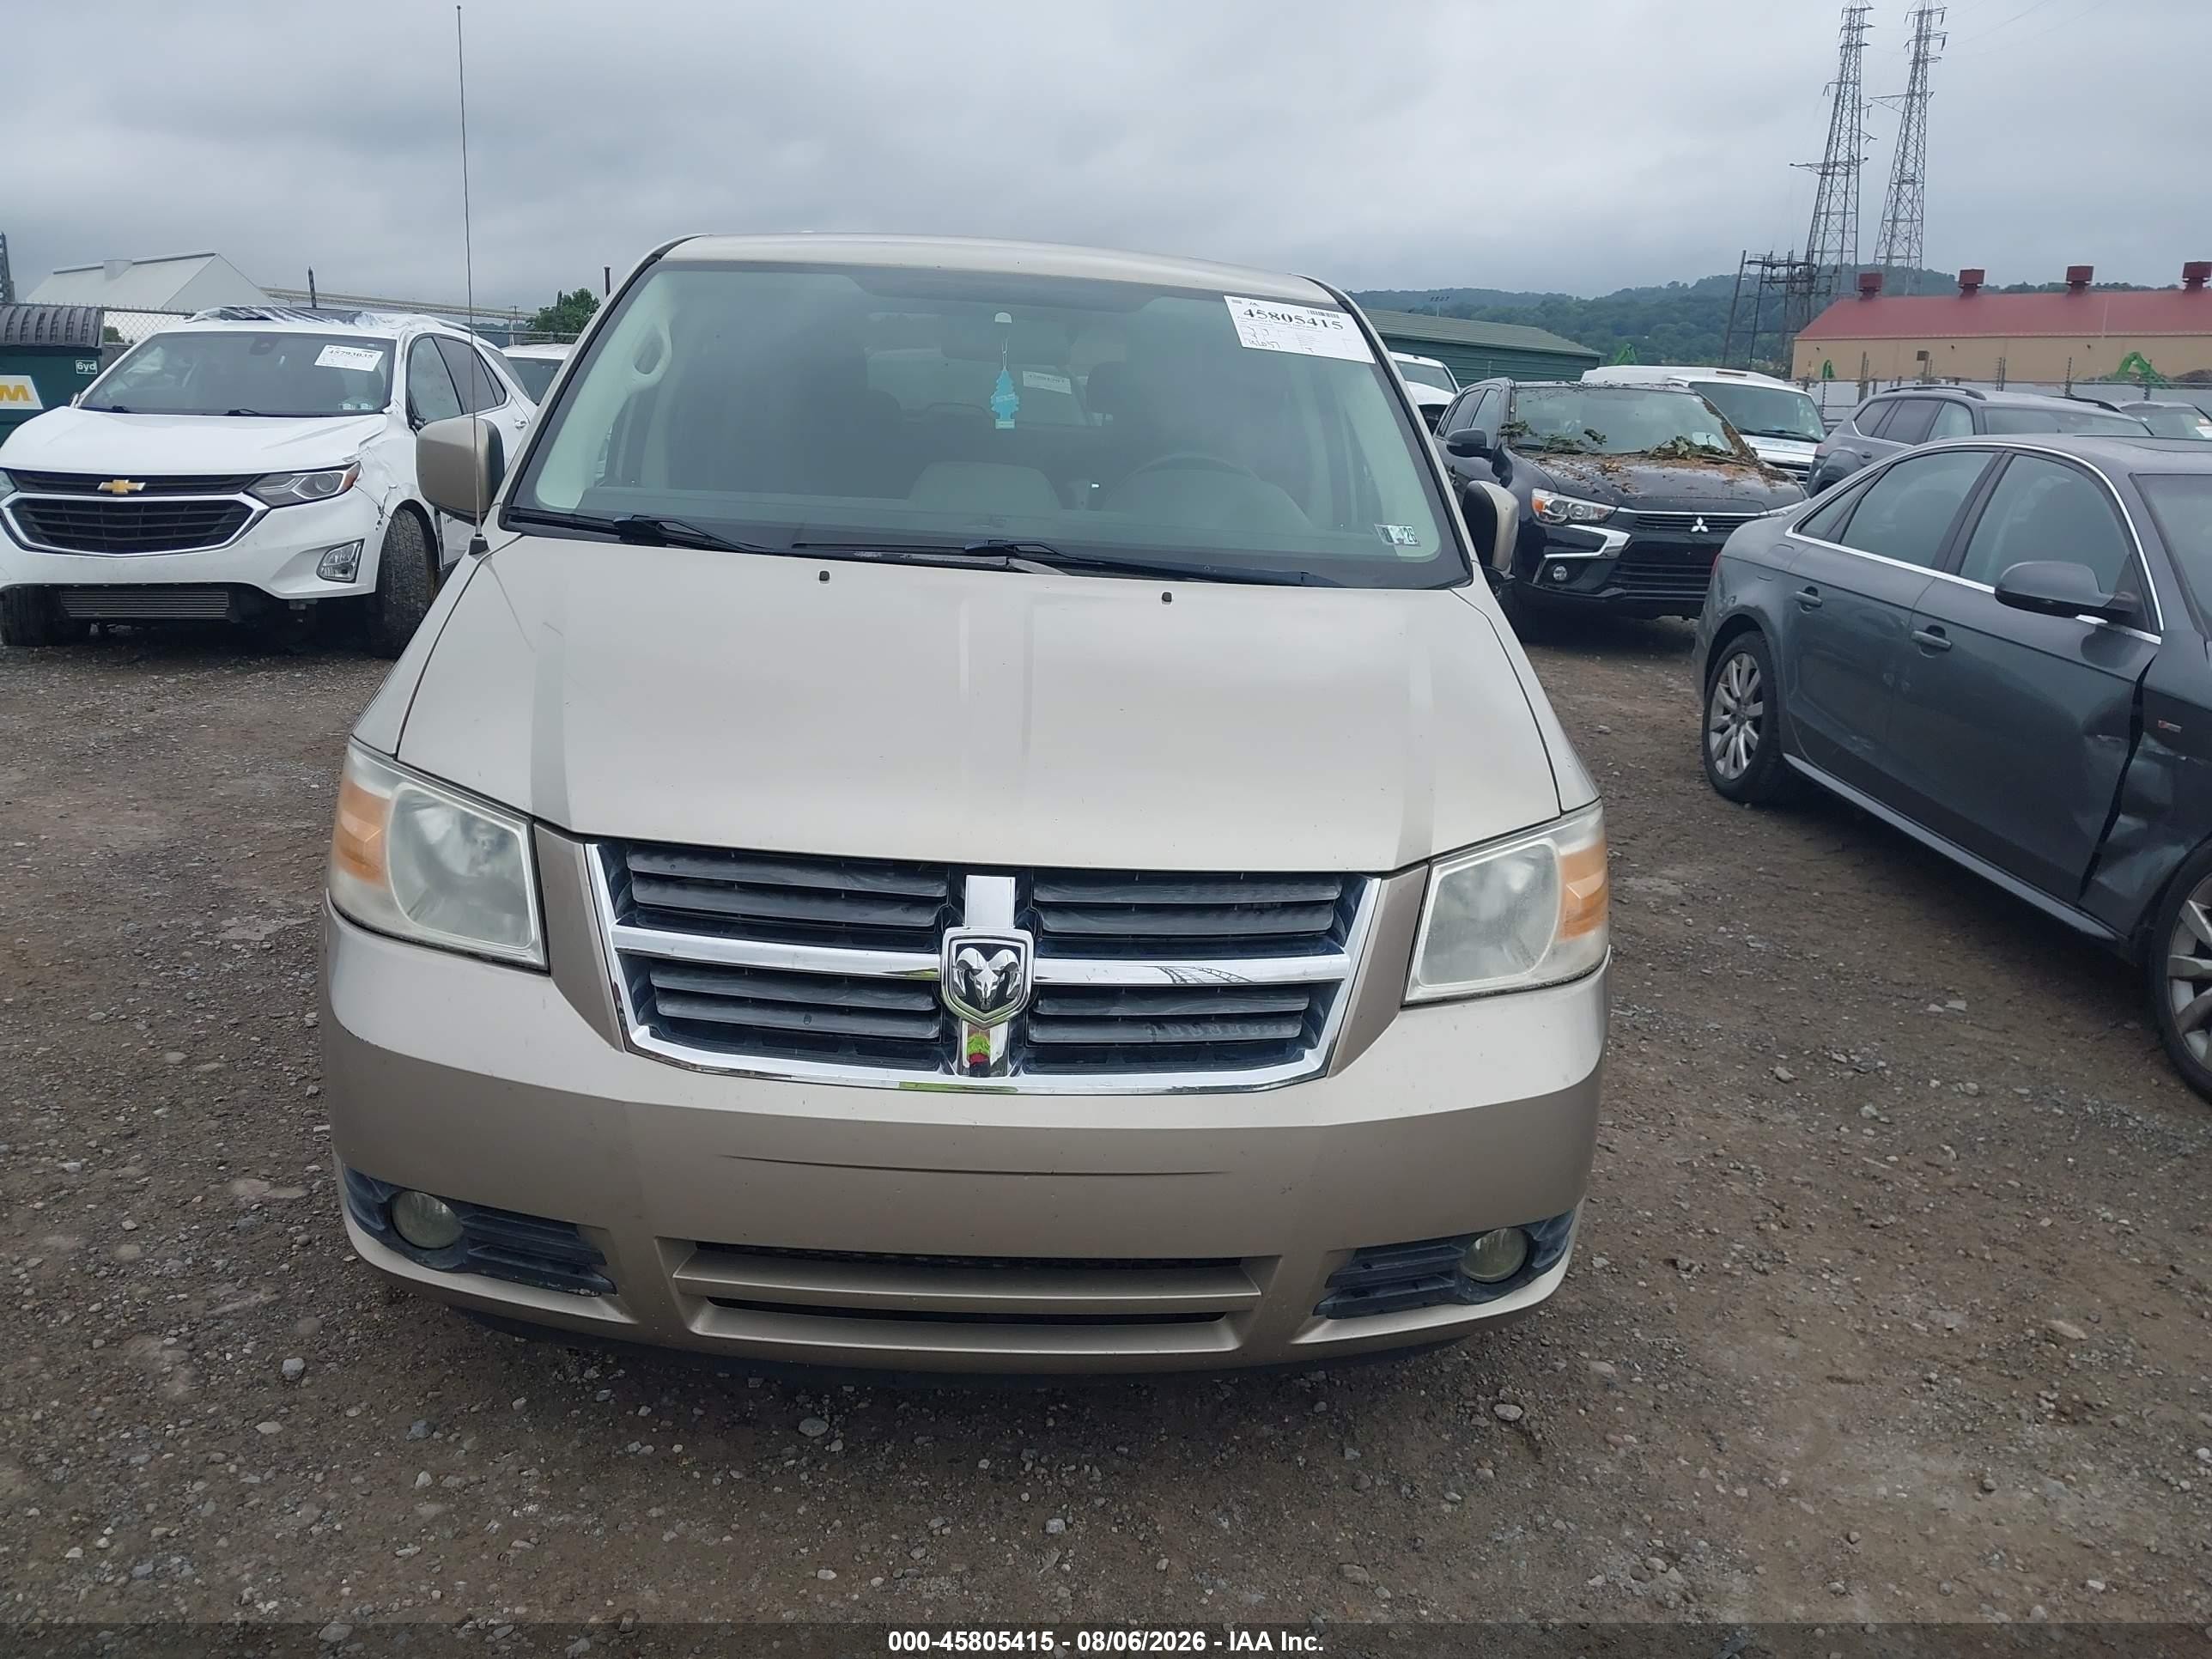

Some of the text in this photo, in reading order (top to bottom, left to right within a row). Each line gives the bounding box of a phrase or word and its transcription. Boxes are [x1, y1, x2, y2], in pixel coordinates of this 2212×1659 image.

[1243, 308, 1344, 330] 45805415
[77, 362, 96, 372] 6yd
[1403, 526, 1418, 543] 26
